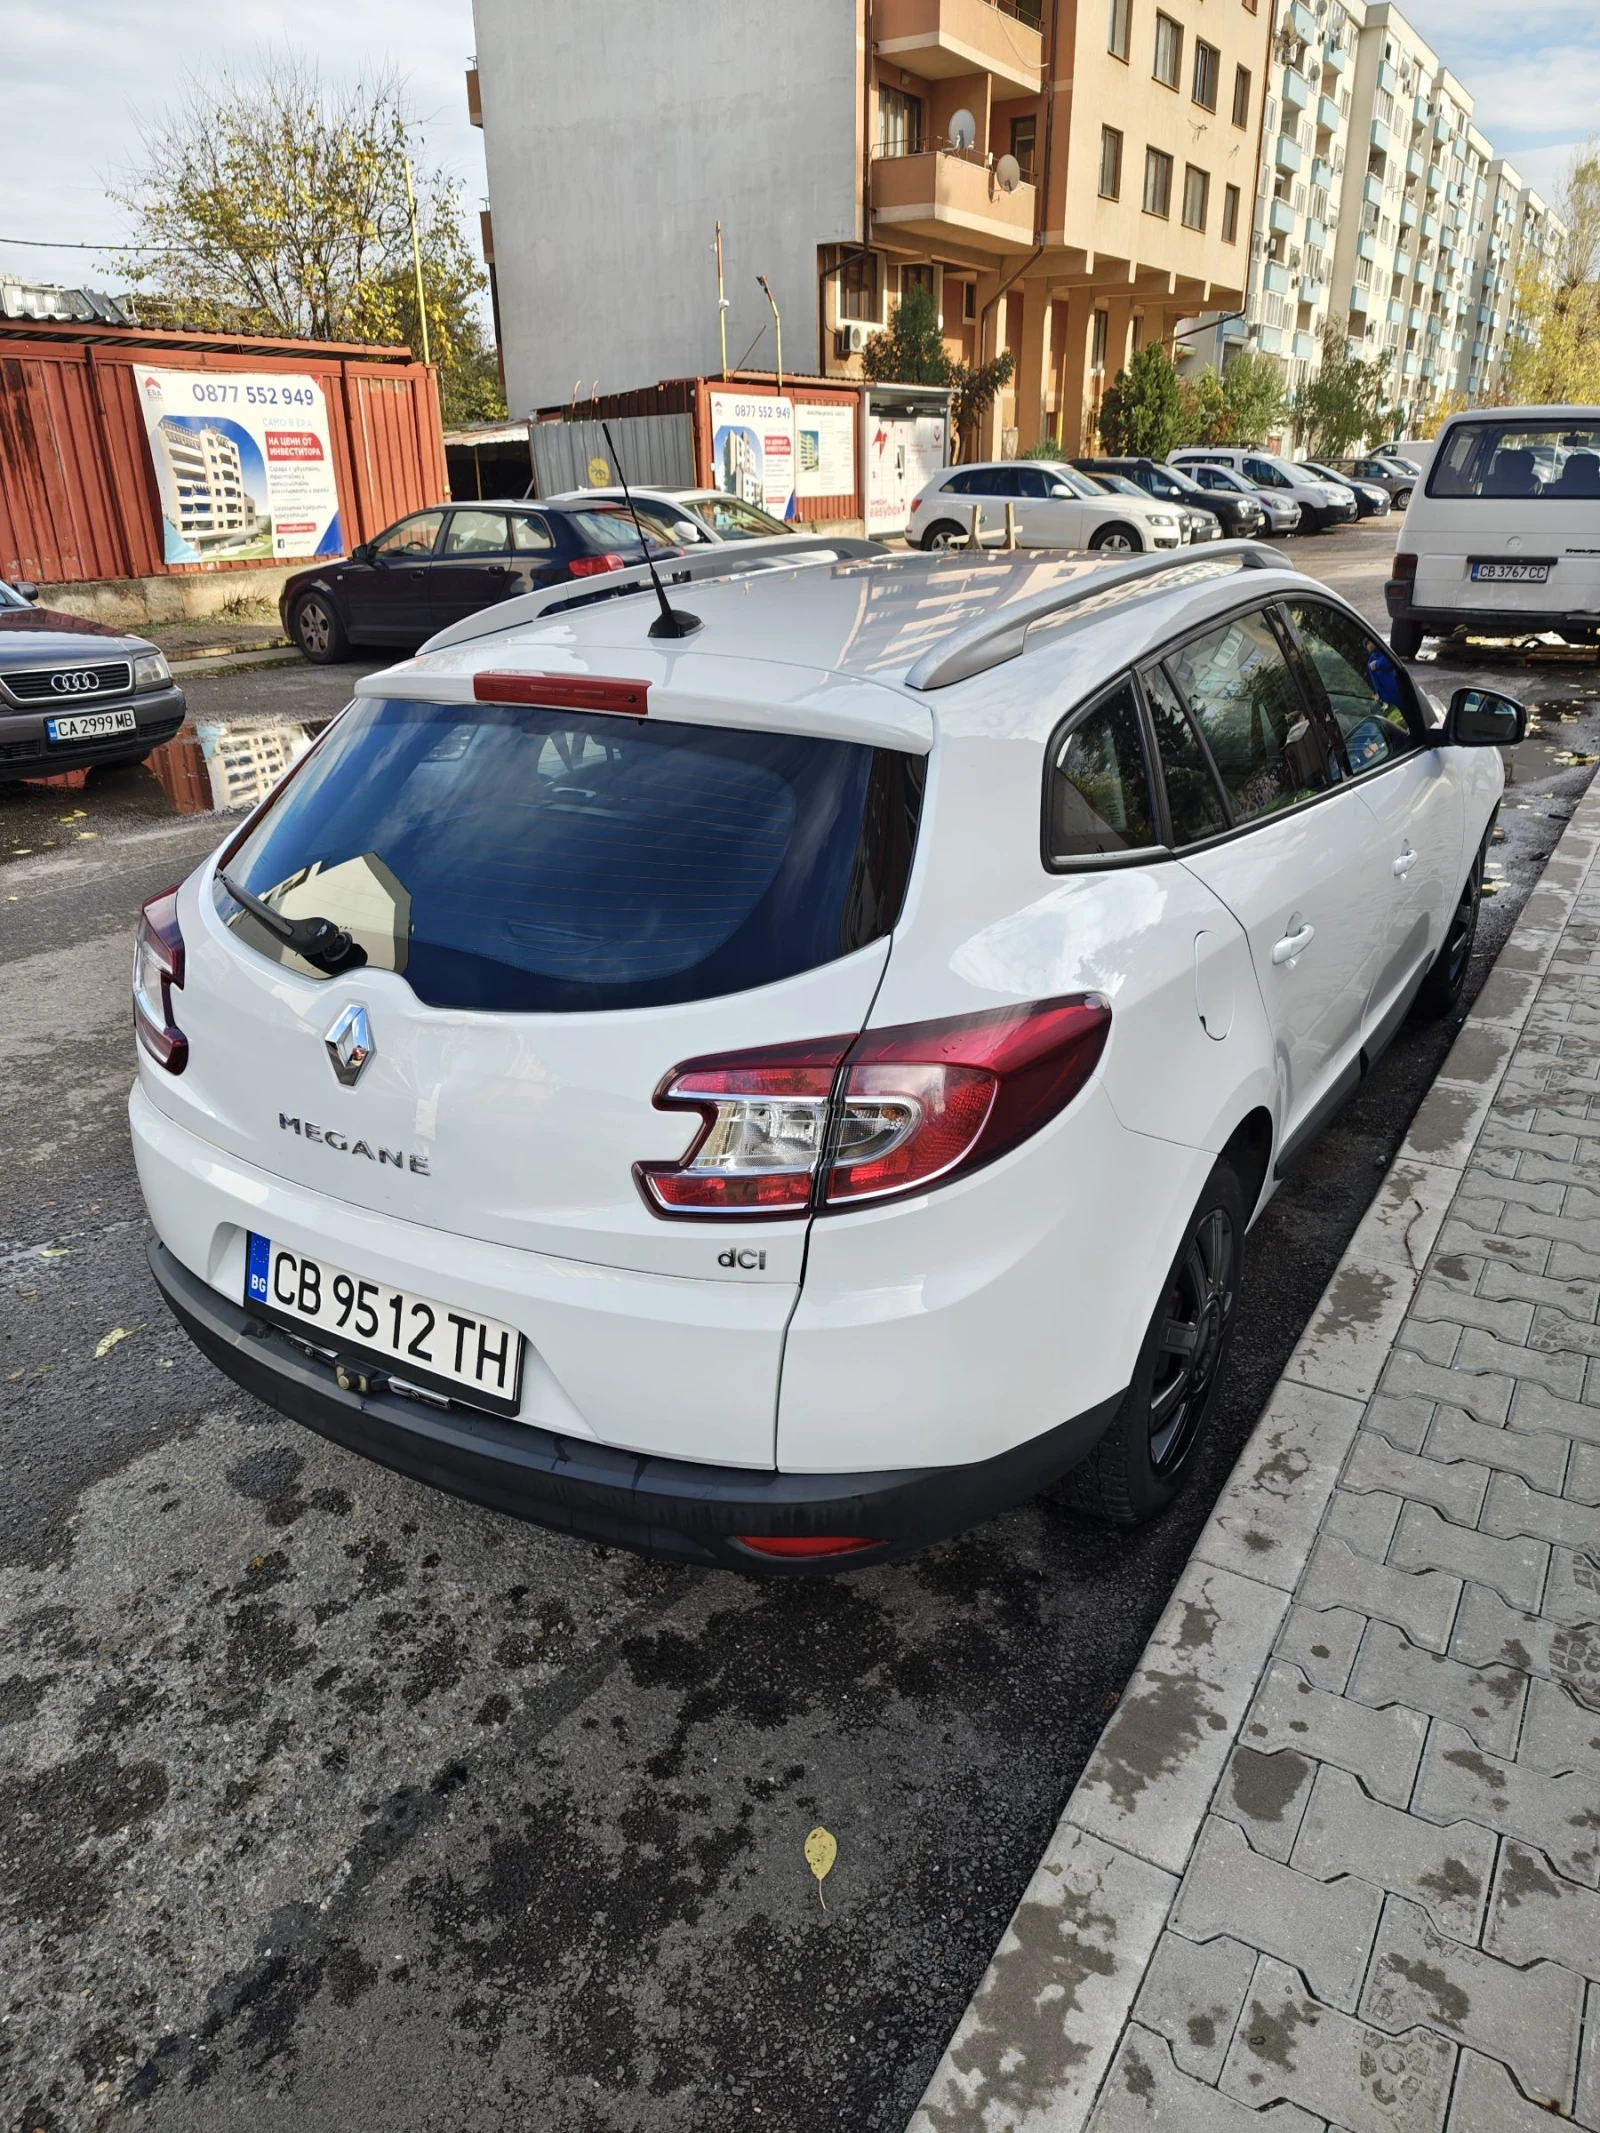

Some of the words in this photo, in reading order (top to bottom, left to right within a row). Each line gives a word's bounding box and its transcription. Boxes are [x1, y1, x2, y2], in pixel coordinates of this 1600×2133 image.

[192, 383, 239, 403] 0877
[246, 386, 278, 405] 552
[282, 387, 314, 406] 949
[735, 404, 756, 418] 0877
[758, 406, 772, 418] 552
[776, 407, 790, 419] 949
[263, 417, 287, 428] САМО
[288, 418, 294, 428] В
[296, 418, 313, 428] ЕРА
[268, 436, 280, 446] НА
[280, 436, 301, 447] ЦЕНИ
[302, 436, 312, 446] ОТ
[269, 447, 322, 456] ИНВЕСТИТОРА
[1480, 565, 1496, 578] CB
[1497, 566, 1527, 578] 3767
[1528, 566, 1545, 579] CC
[58, 720, 78, 737] CA
[80, 715, 113, 734] 2999
[115, 712, 133, 729] MB
[278, 1110, 431, 1176] MEGANE
[251, 1273, 267, 1293] BG
[273, 1251, 322, 1315] CB
[333, 1274, 436, 1363] 9512
[447, 1312, 509, 1389] TH
